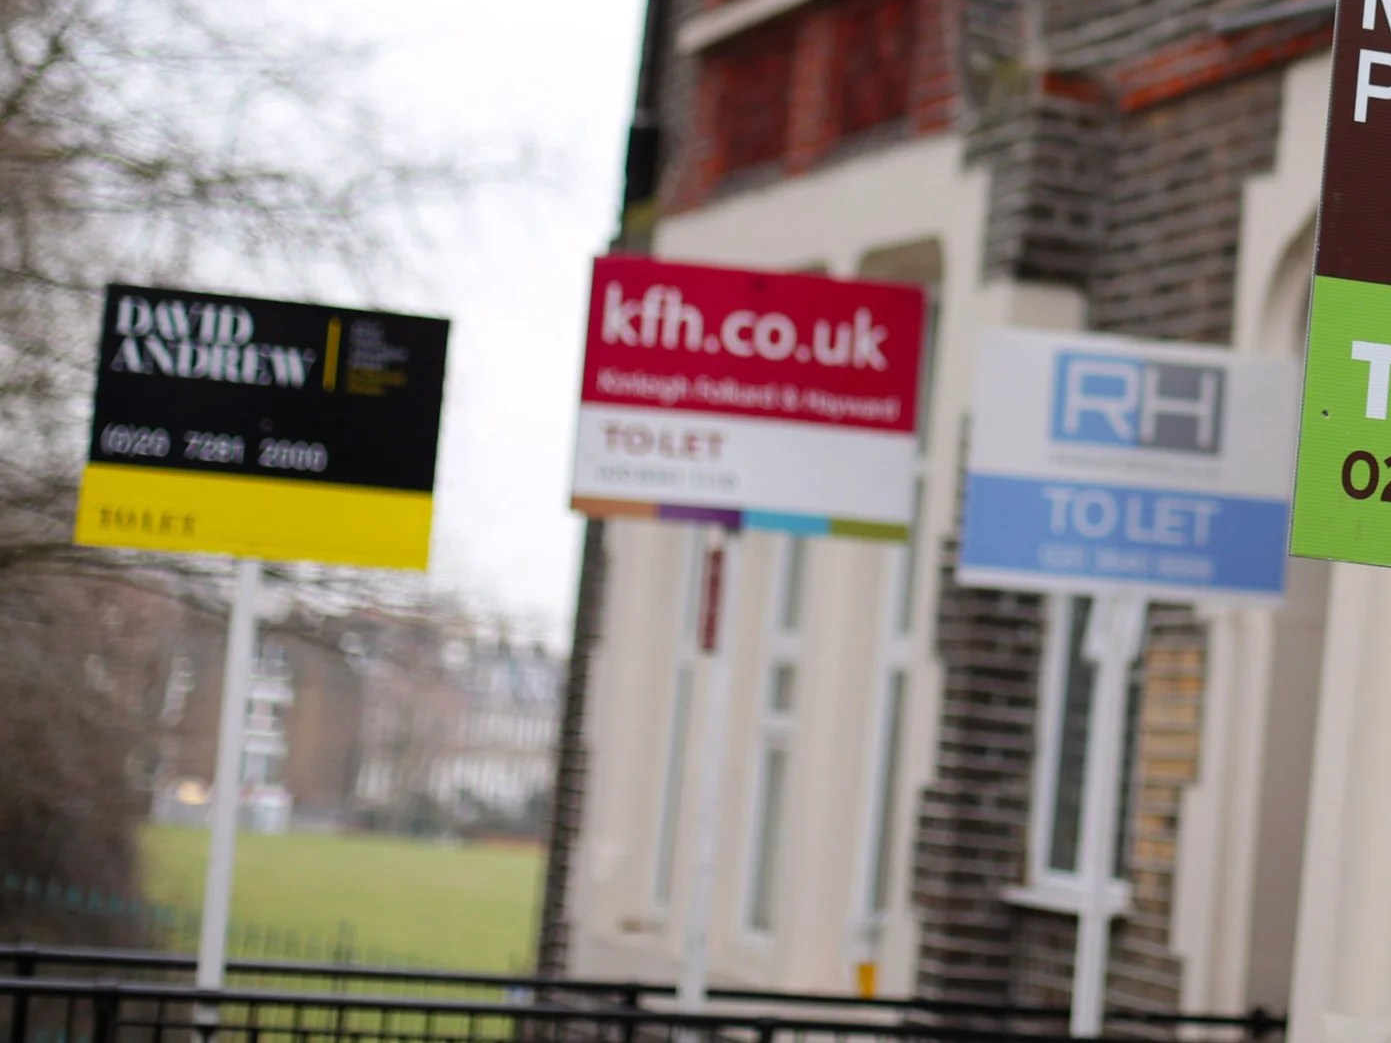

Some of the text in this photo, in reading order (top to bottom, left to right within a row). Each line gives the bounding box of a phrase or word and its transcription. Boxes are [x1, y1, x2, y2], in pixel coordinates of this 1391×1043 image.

[116, 295, 254, 345] DAVID
[601, 280, 889, 372] kfh.co.uk
[110, 336, 316, 388] ANDREW
[1062, 357, 1219, 449] RH
[601, 421, 728, 463] TO LET
[1042, 486, 1220, 547] TO LET
